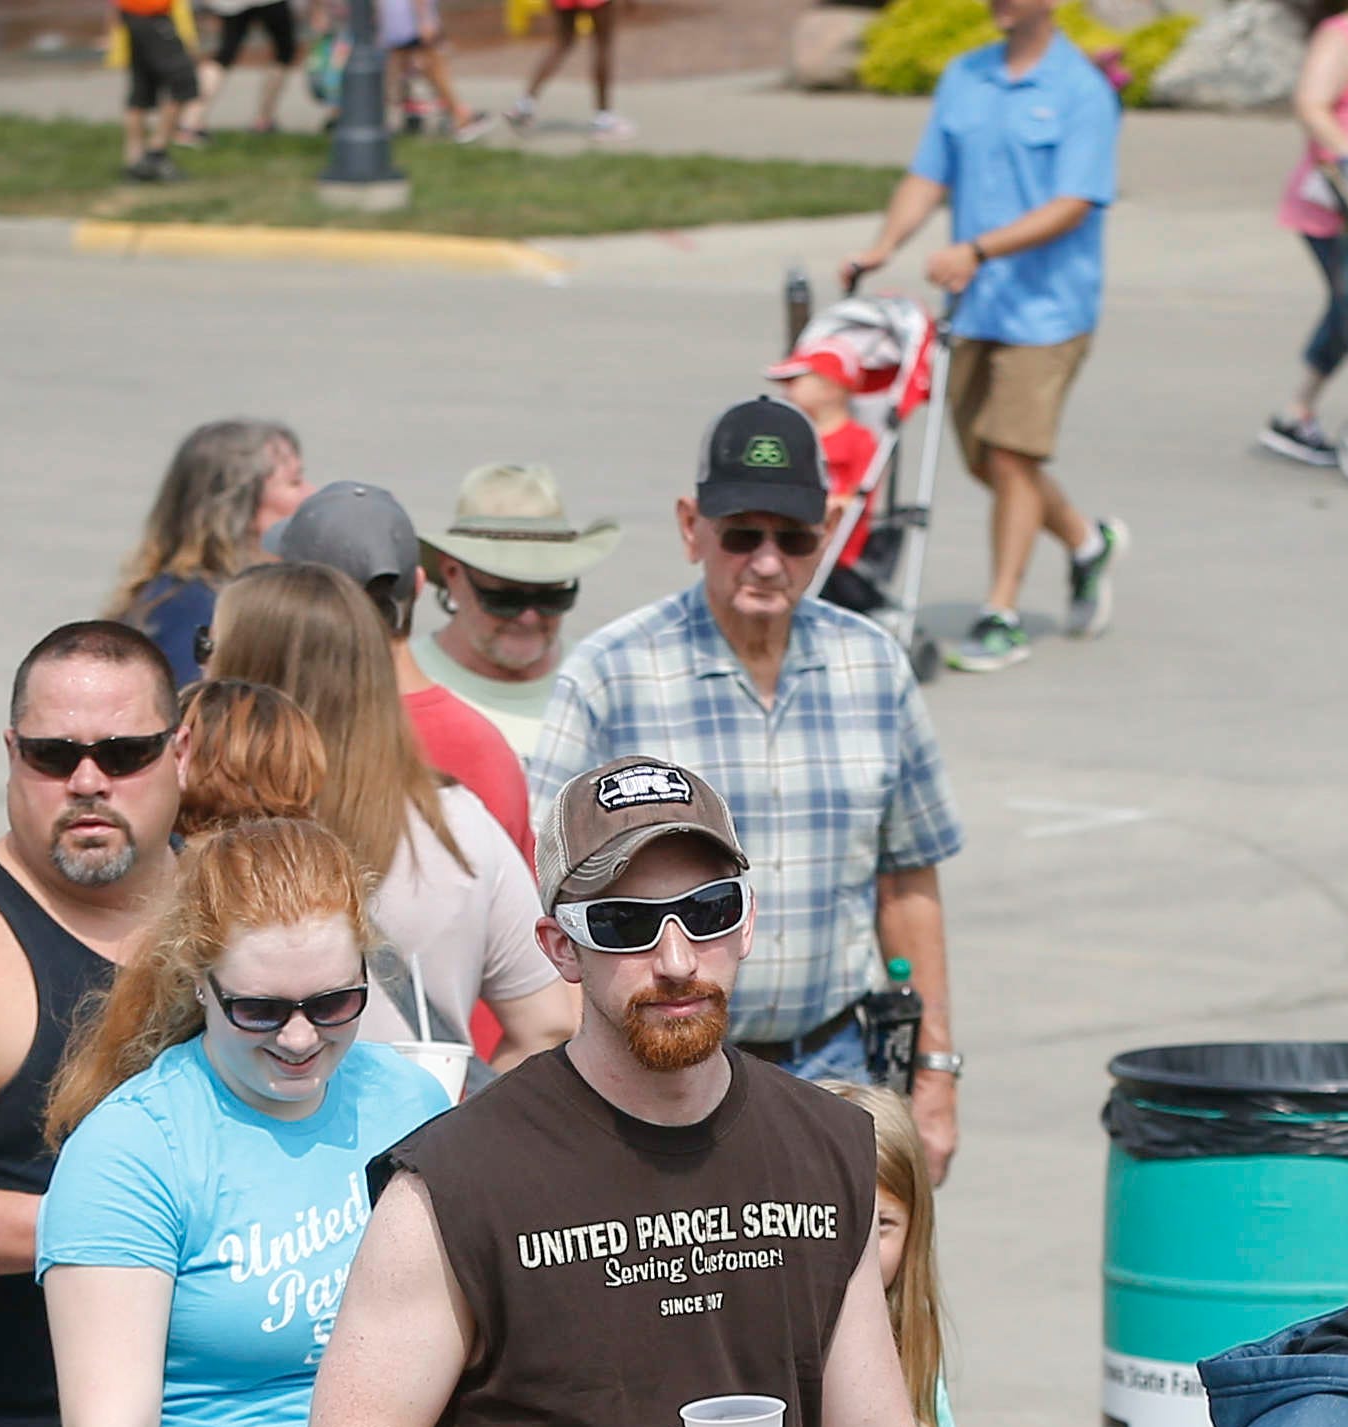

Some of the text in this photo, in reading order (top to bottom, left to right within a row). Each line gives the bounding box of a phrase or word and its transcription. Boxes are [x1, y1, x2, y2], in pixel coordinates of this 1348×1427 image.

[217, 1171, 370, 1283] United
[518, 1203, 839, 1269] UNITED PARCEL SERVICE
[605, 1257, 688, 1286] Serving
[660, 1295, 704, 1316] SINCE
